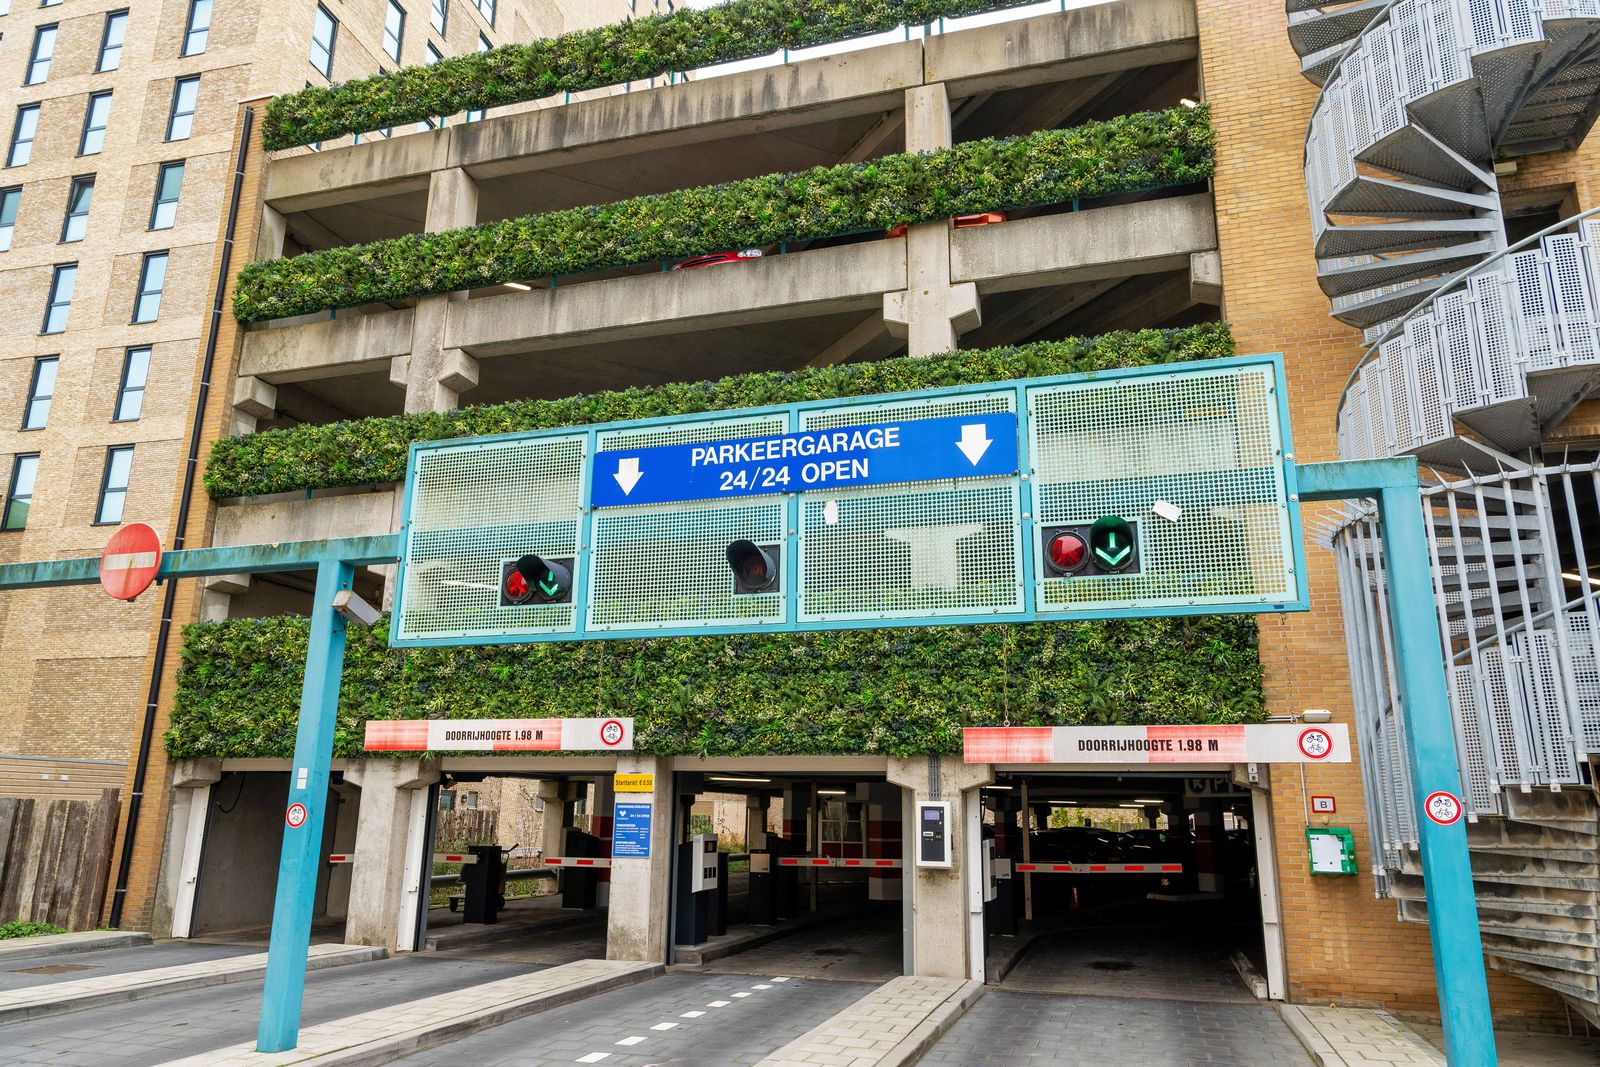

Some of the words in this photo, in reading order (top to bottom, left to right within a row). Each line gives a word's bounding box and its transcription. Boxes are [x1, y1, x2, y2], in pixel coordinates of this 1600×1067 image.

[691, 427, 900, 467] PARKEERGARAGE
[719, 465, 791, 491] 24/24
[801, 458, 869, 484] OPEN
[445, 730, 512, 741] DOORRIJHOOGTE
[515, 730, 532, 741] 1.98
[535, 730, 544, 741] M
[1078, 739, 1173, 752] DOORRIJHOOGTE
[1177, 739, 1203, 752] 1.98
[1208, 739, 1219, 752] M
[1320, 801, 1328, 809] B
